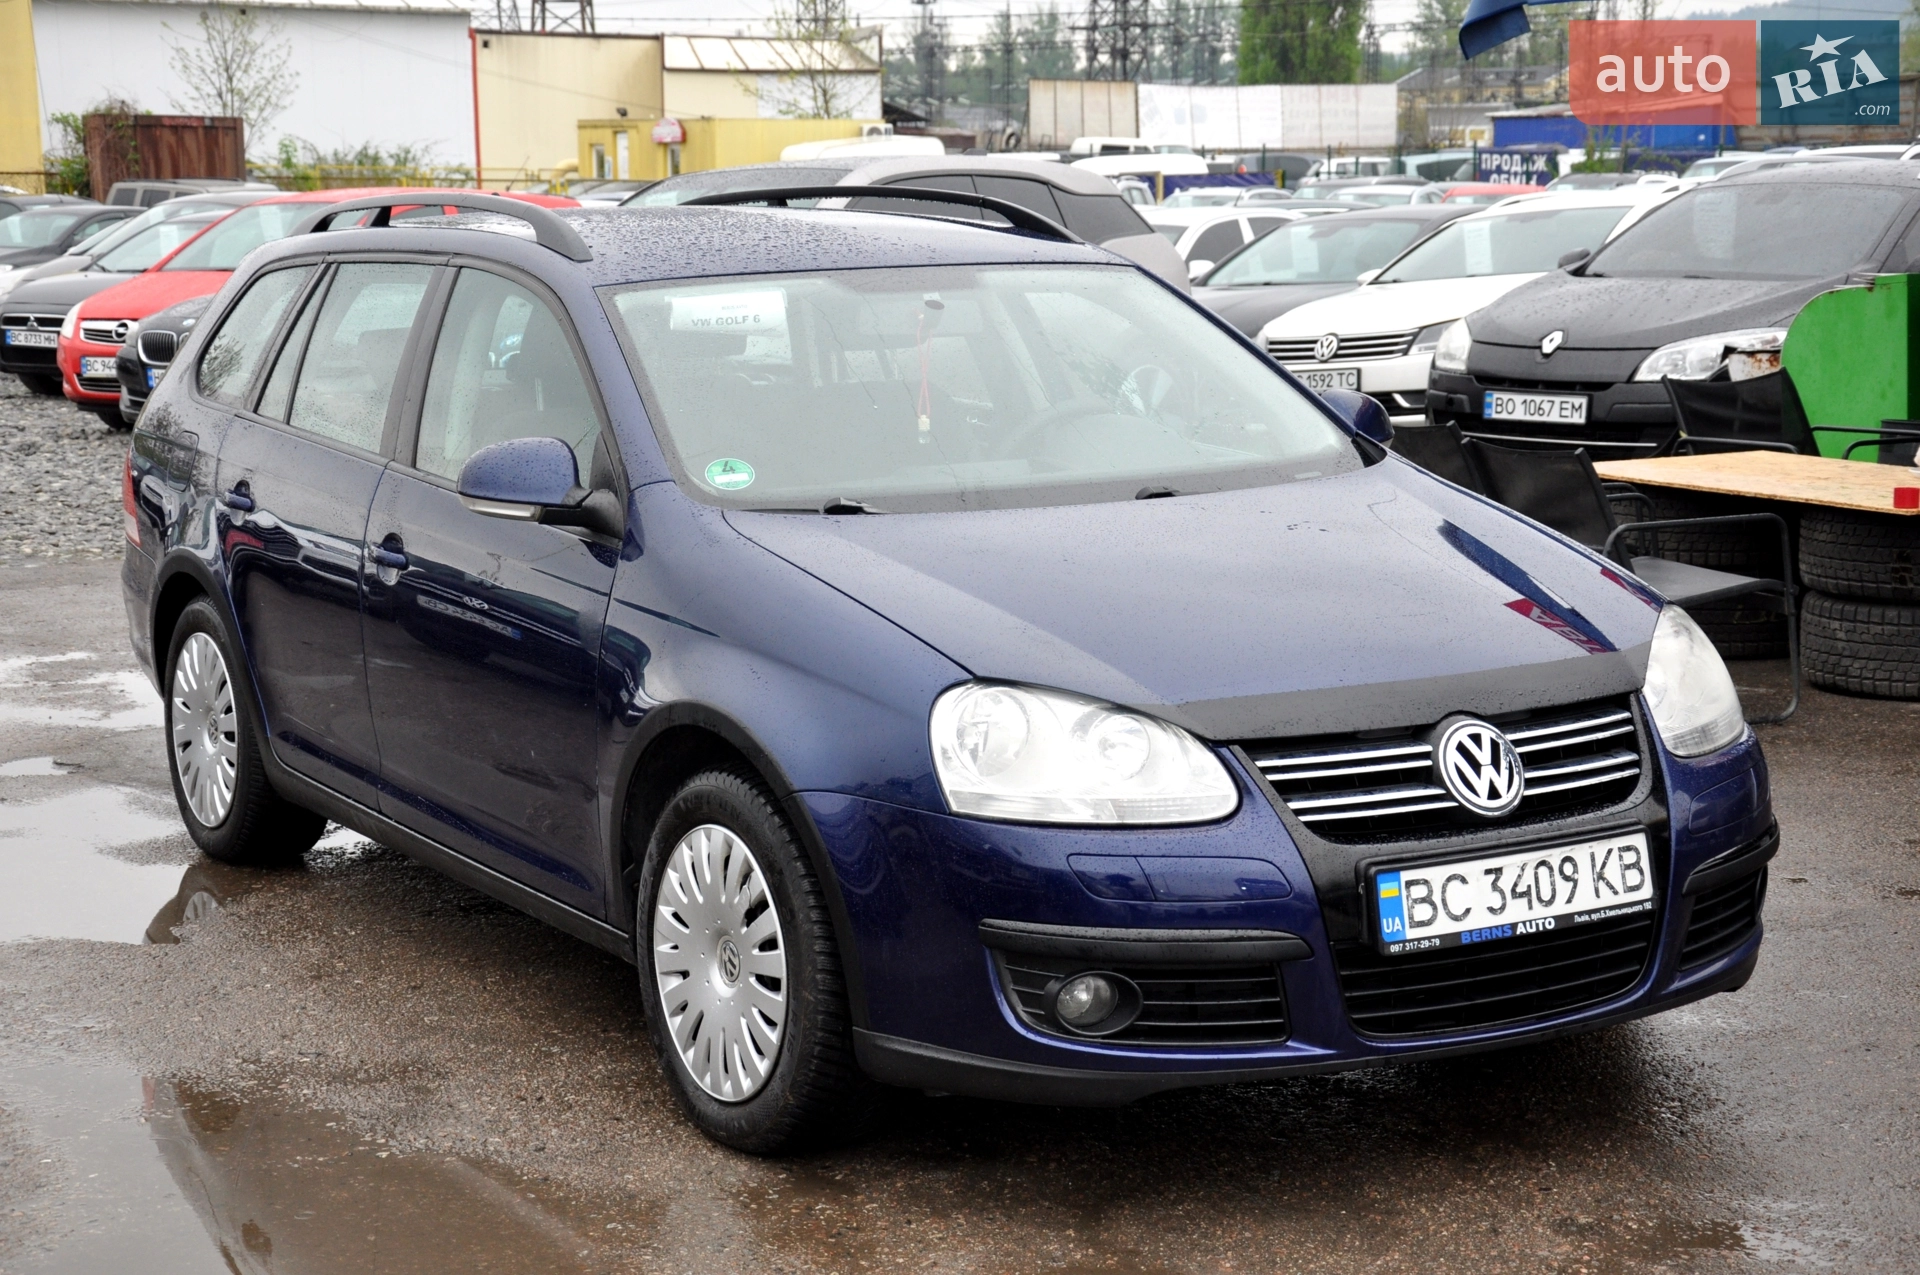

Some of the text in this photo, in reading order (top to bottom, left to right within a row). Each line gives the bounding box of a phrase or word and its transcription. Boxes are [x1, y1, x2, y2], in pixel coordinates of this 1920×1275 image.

[691, 314, 761, 327] VW GOLF 6
[11, 331, 56, 345] BC 8733 MH
[86, 359, 99, 372] BC
[1306, 372, 1334, 389] 1592
[1336, 371, 1356, 388] TC
[1495, 396, 1584, 419] BO 1067 EM
[721, 460, 736, 474] 4
[1404, 843, 1646, 930] BC 3409 KB
[1643, 901, 1653, 910] 192
[1383, 916, 1403, 934] UA
[1461, 917, 1556, 944] BERNS AUTO
[1389, 938, 1441, 953] 097 317-29-79
